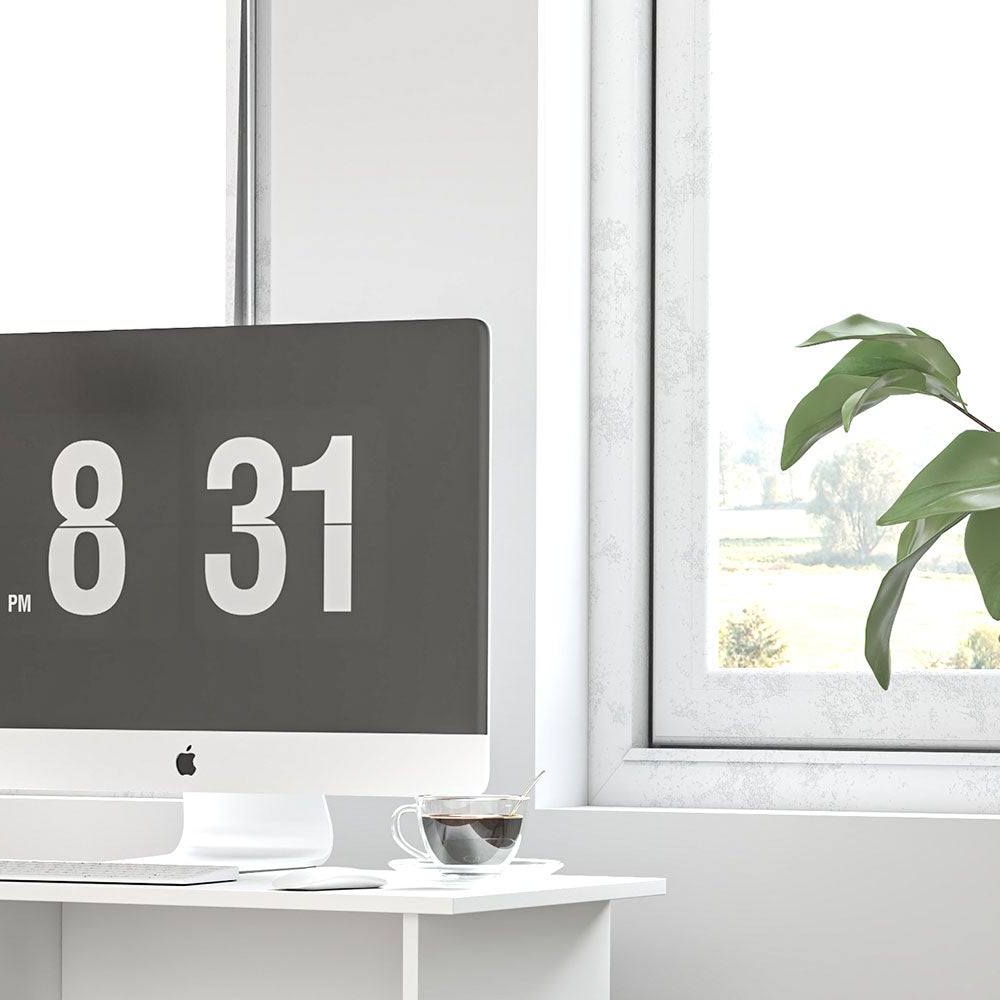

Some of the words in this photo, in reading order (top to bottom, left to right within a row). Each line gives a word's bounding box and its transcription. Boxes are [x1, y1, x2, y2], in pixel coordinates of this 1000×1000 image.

[8, 594, 31, 613] PM
[48, 439, 126, 616] 8
[205, 435, 353, 616] 31
